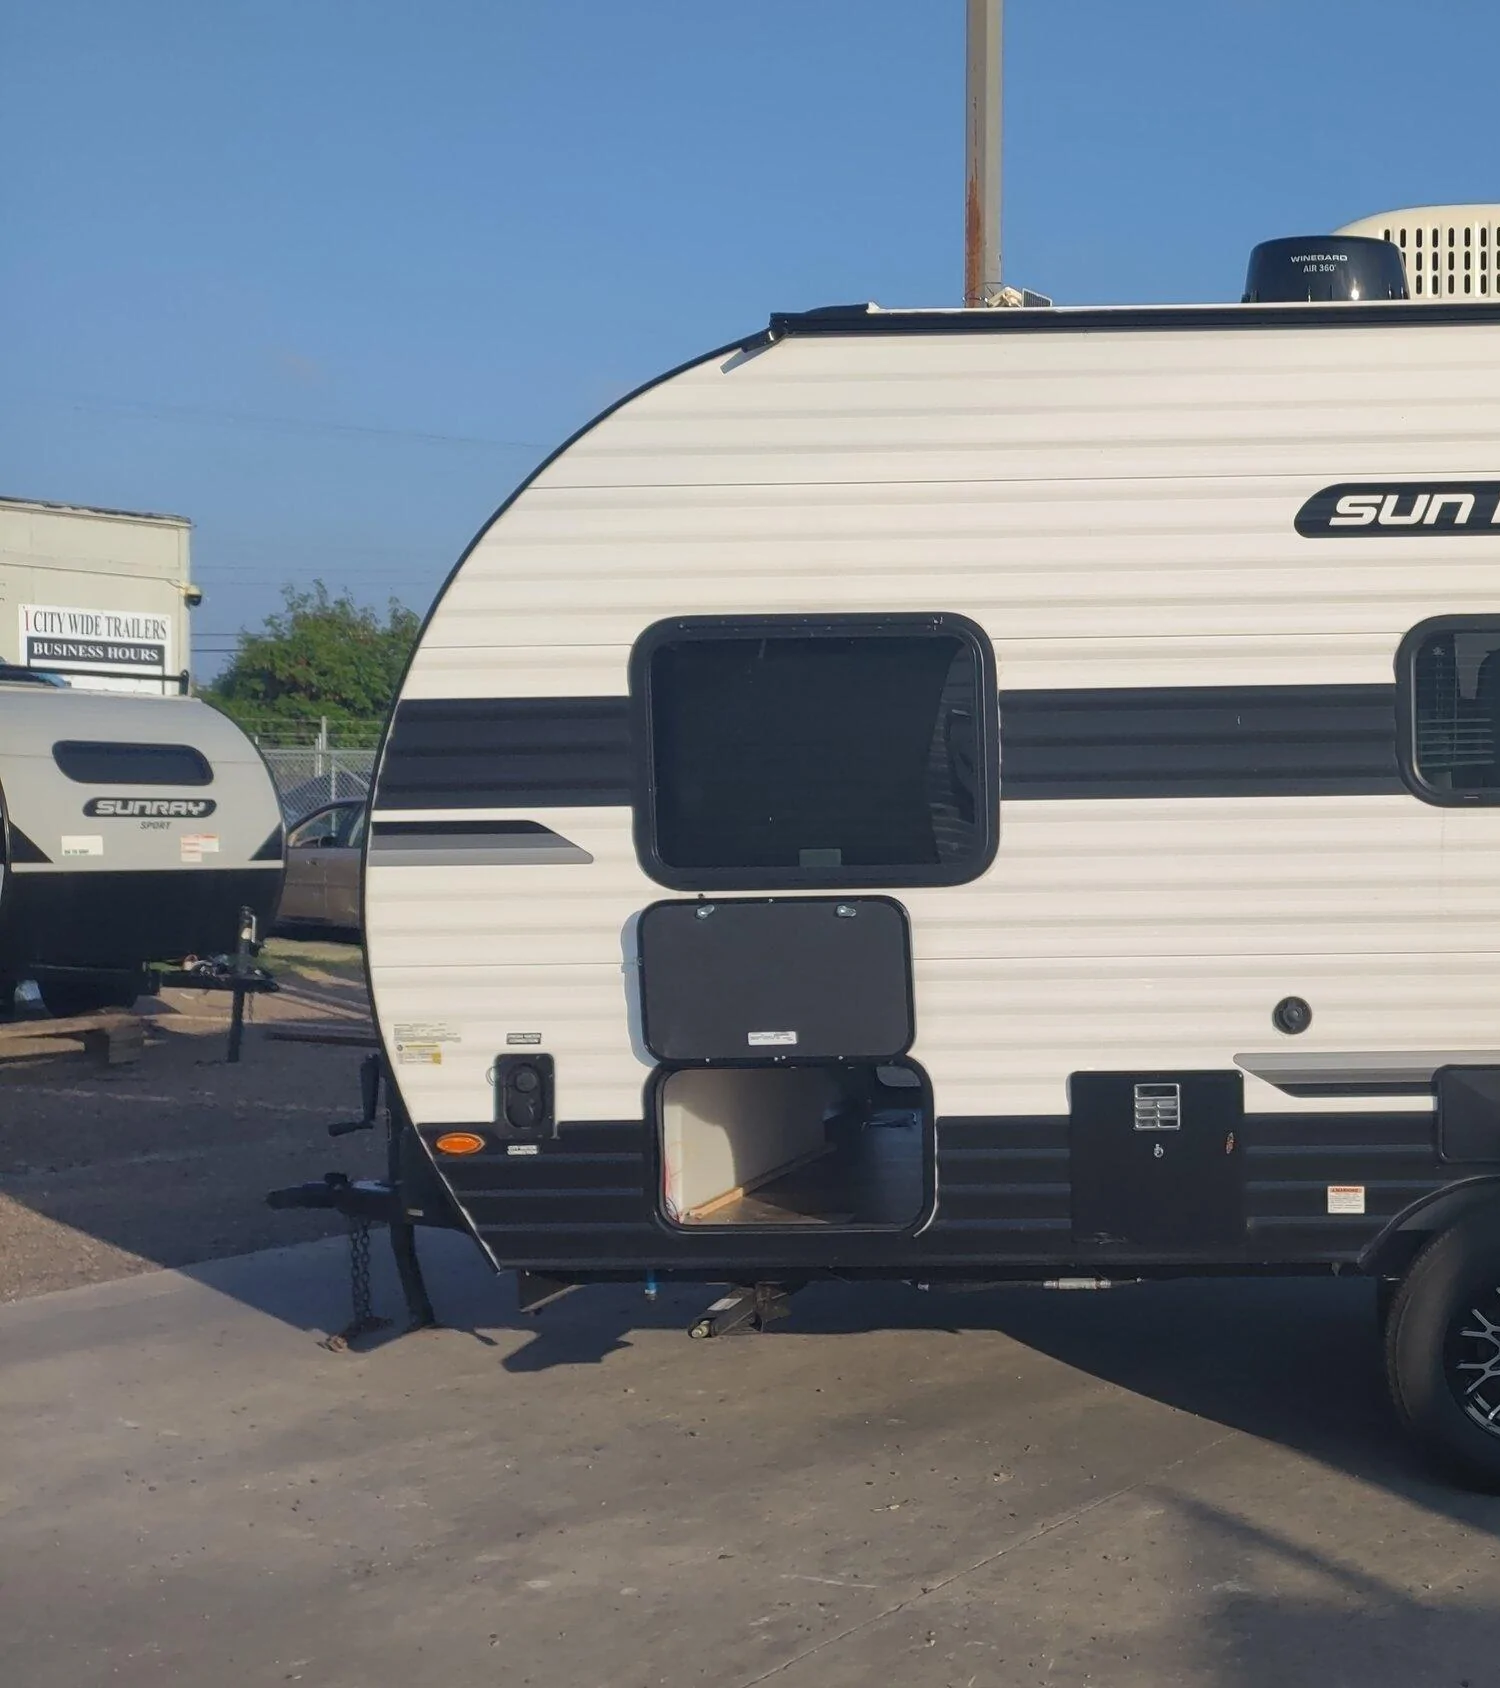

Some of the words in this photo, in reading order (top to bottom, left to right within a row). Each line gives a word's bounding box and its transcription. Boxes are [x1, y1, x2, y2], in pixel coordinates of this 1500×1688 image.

[1290, 254, 1348, 263] WINEGARD
[1303, 265, 1318, 273] AIR
[1329, 493, 1475, 526] SUN
[33, 610, 67, 634] CITY
[68, 613, 101, 636] WIDE
[105, 616, 167, 640] TRAILERS
[33, 642, 104, 658] BUSINESS
[107, 646, 159, 661] HOURS
[96, 800, 206, 815] SUNRAY
